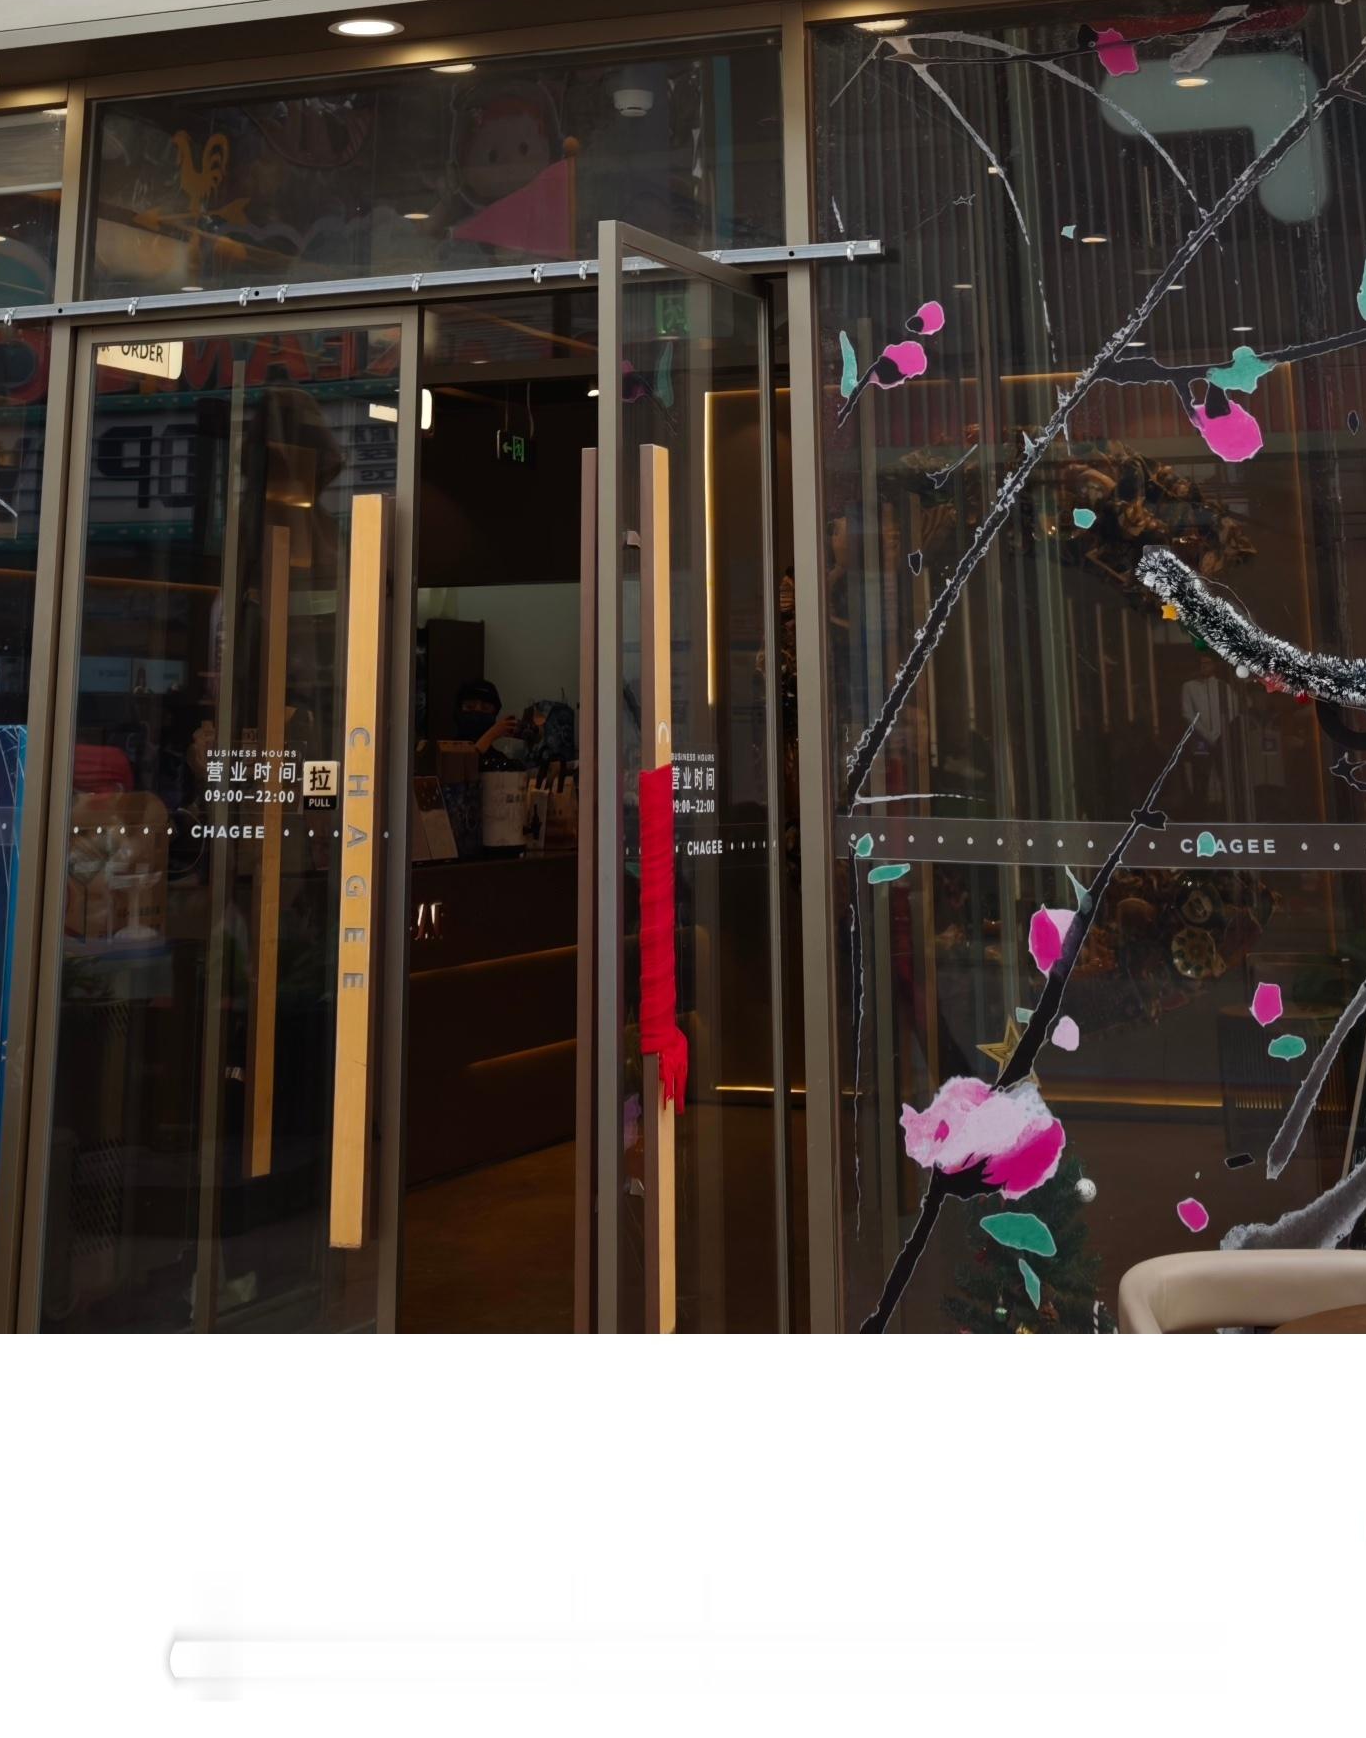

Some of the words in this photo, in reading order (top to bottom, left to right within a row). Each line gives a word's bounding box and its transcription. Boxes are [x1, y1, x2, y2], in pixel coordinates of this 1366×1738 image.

[121, 343, 164, 364] ORDER
[207, 749, 258, 758] BUSINESS
[261, 749, 298, 758] HOURS
[206, 761, 297, 784] 营业时间
[310, 765, 331, 792] 拉
[672, 766, 716, 791] 营业时间
[308, 797, 331, 808] PULL
[673, 799, 715, 814] 9:00—22:00
[191, 824, 266, 839] CHAGEE
[687, 839, 723, 856] CHAGEE
[1179, 838, 1277, 855] CAGEE
[342, 726, 371, 989] CHAGEE
